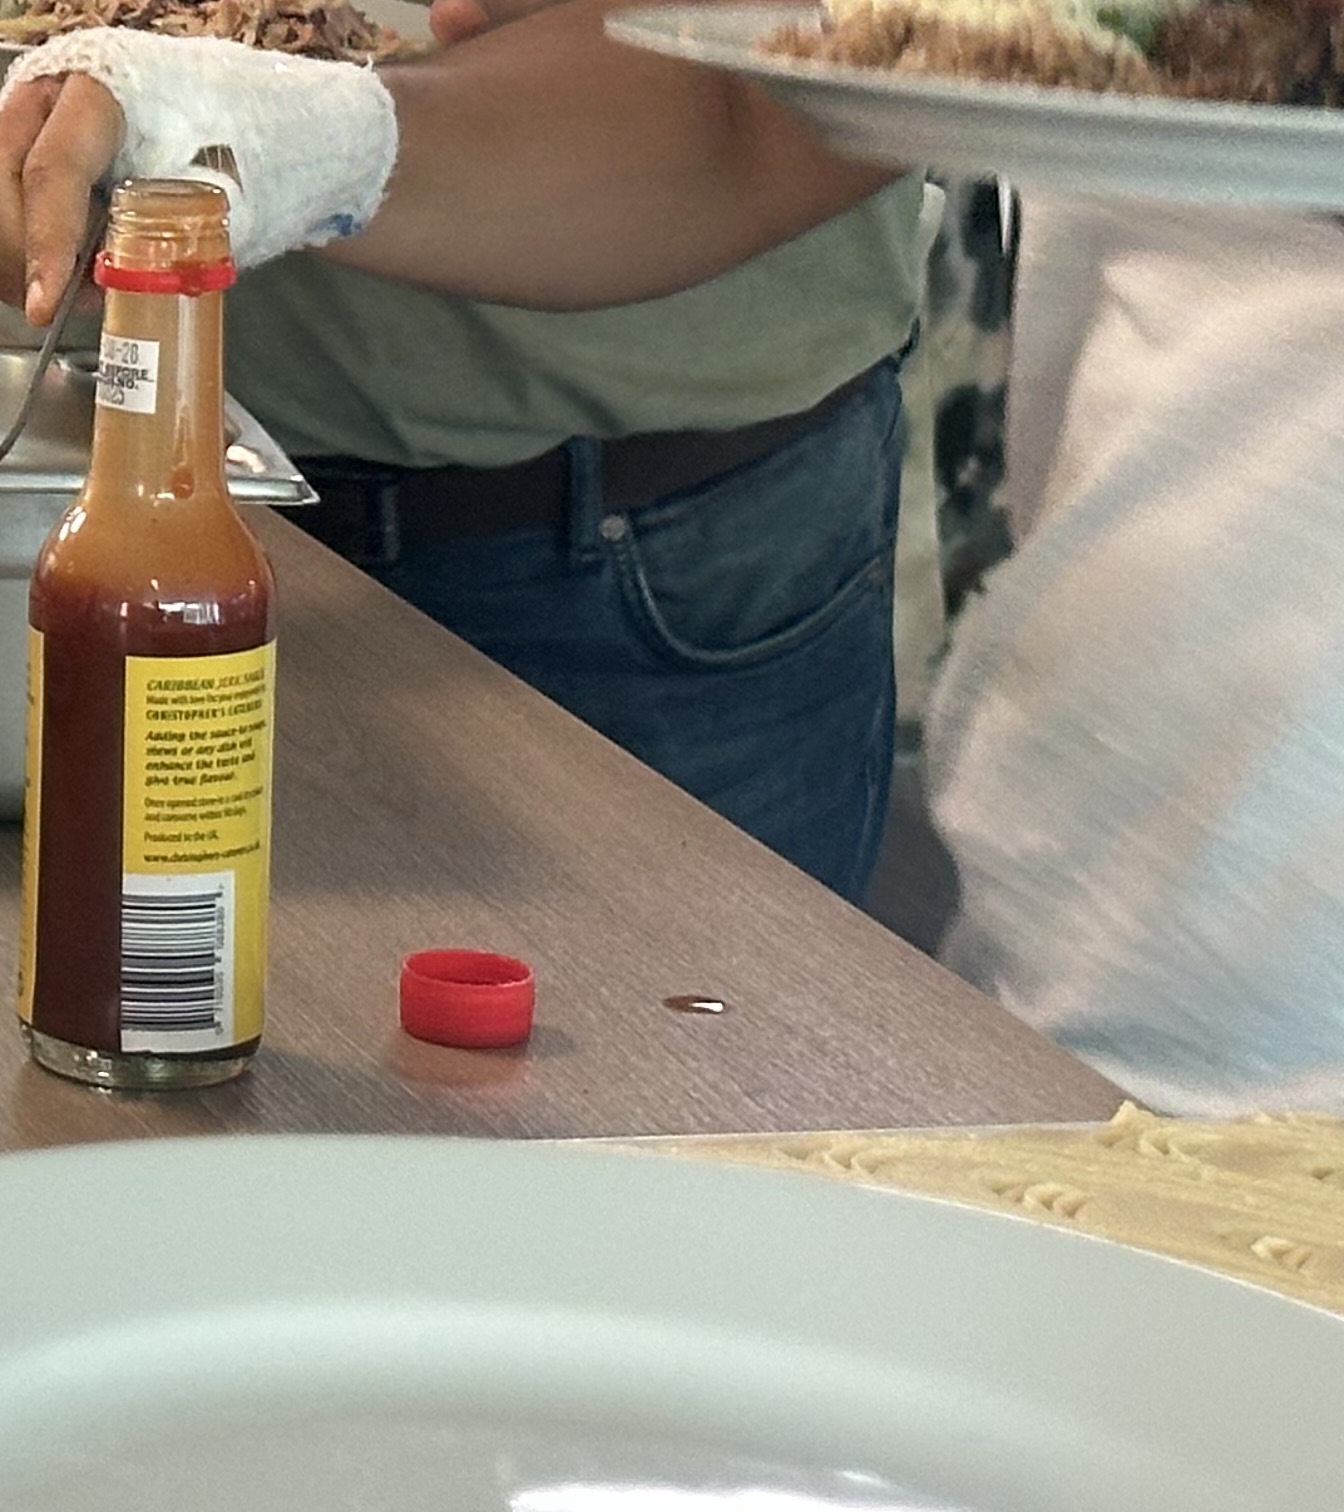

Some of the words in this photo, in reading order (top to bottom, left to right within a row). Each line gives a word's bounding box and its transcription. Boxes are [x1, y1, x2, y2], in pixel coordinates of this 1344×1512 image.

[145, 729, 186, 743] Adding
[188, 729, 208, 742] the
[180, 746, 194, 757] or
